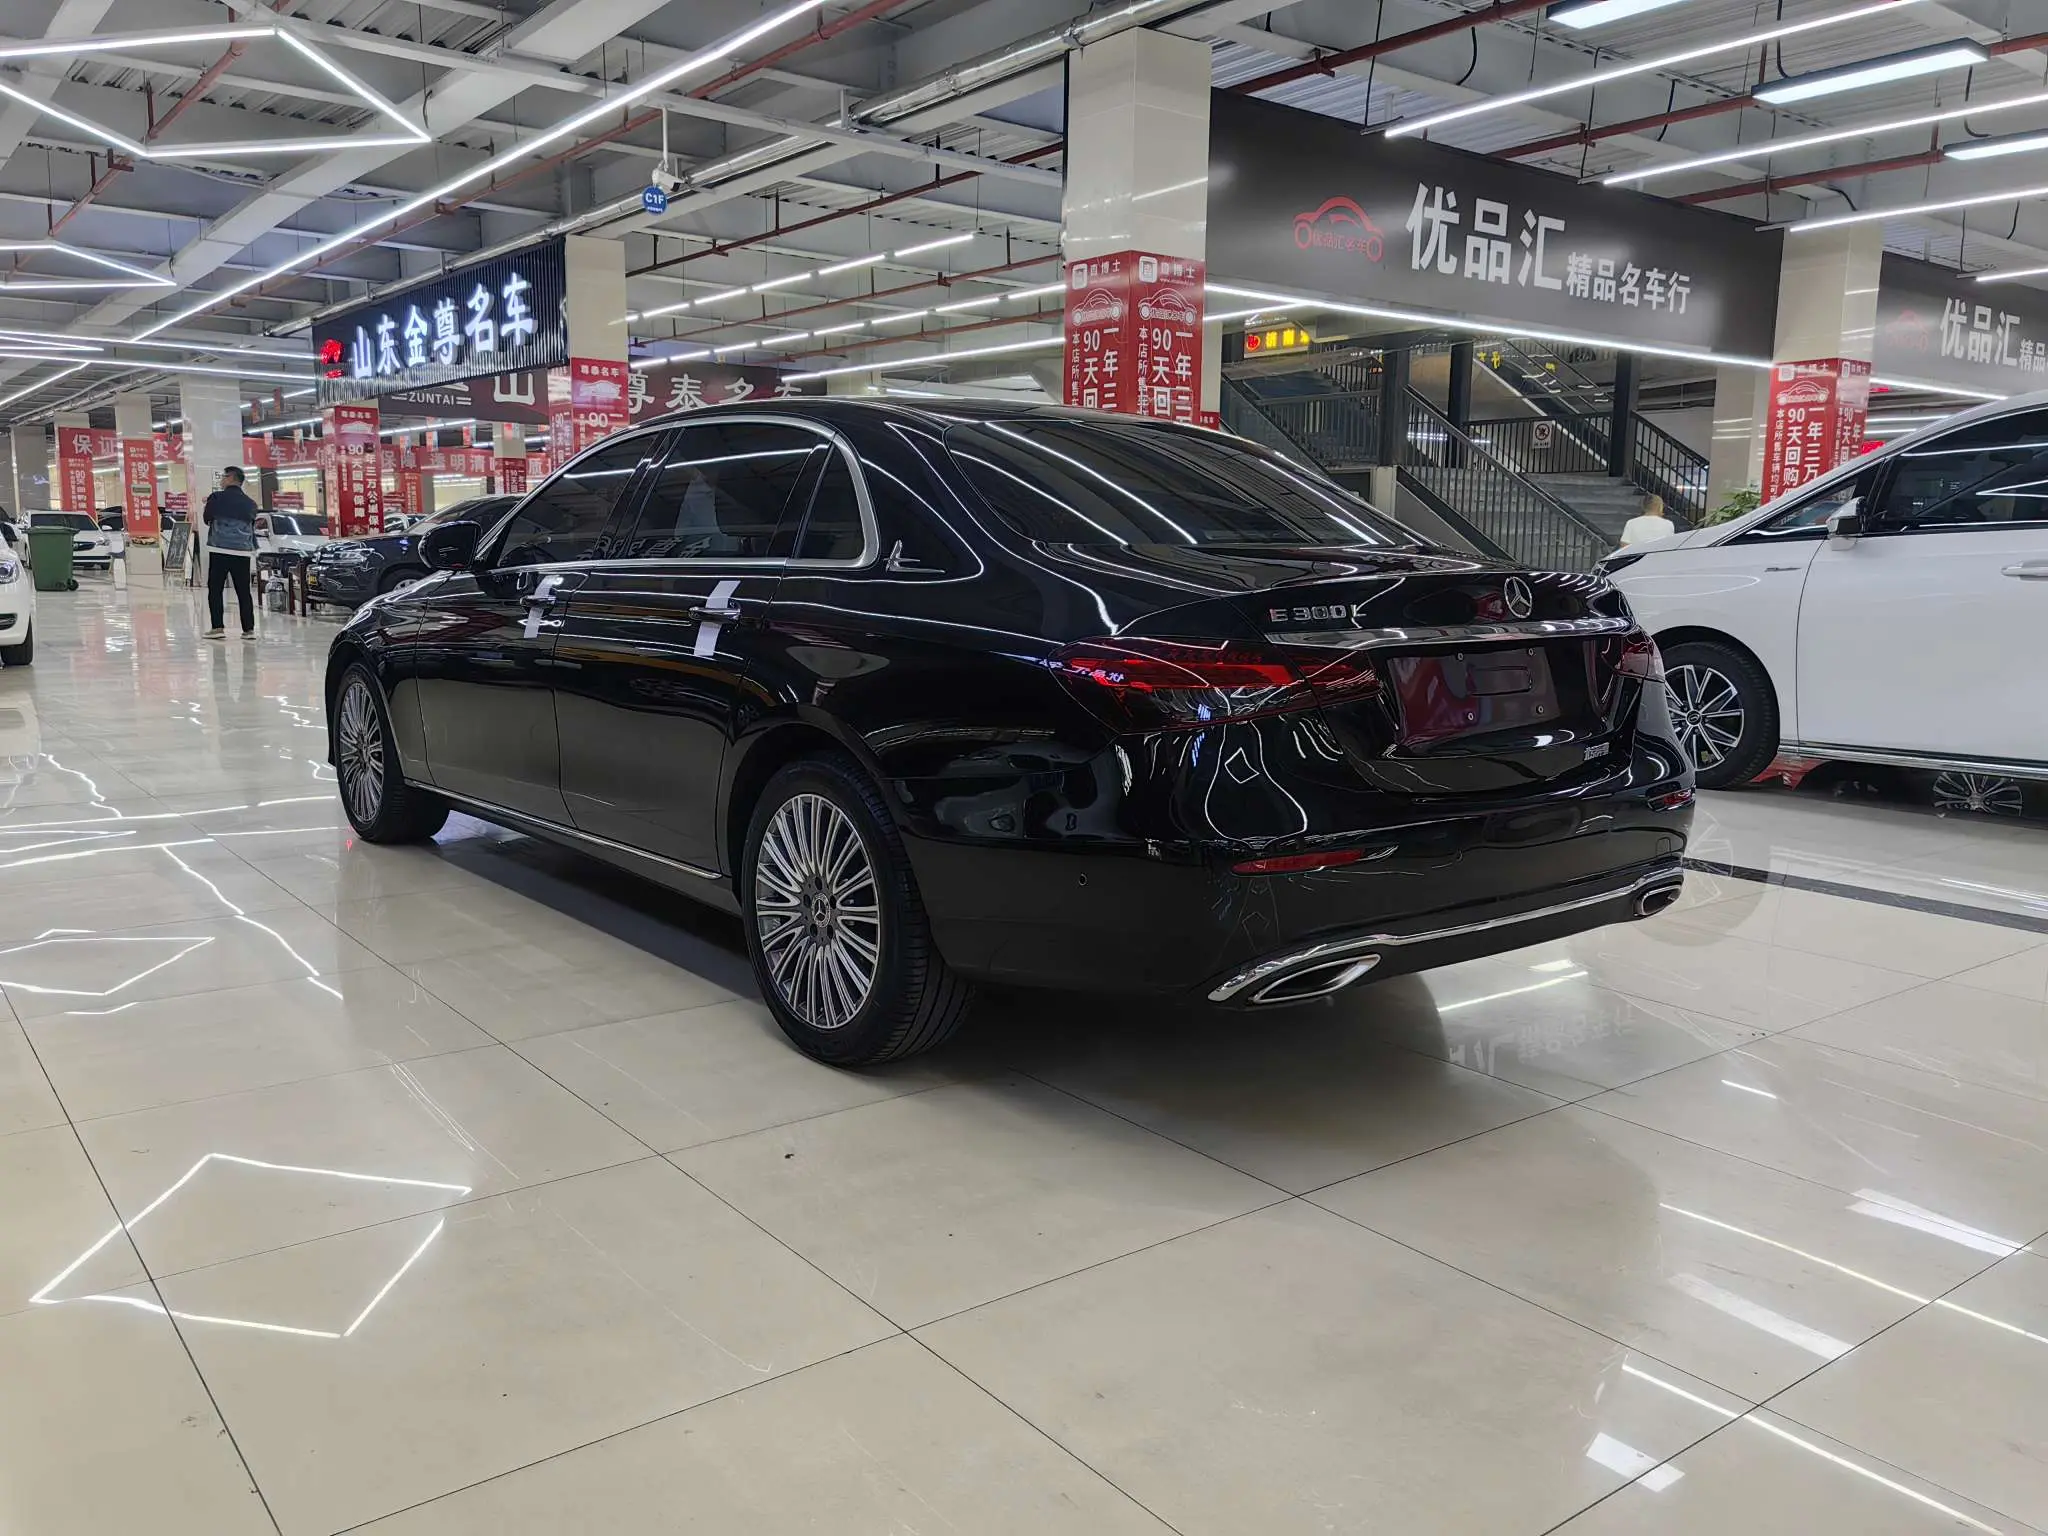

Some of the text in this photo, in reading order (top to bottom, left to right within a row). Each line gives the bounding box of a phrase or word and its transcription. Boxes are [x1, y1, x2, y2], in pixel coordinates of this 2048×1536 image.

[645, 193, 664, 204] C1F
[1405, 182, 1691, 315] 优品汇 精品名车行
[351, 271, 538, 380] 山东金尊名车
[1939, 296, 2048, 376] 优品汇 精品
[408, 392, 455, 406] ZUNTAI
[1269, 608, 1288, 623] E
[1292, 604, 1347, 621] 300
